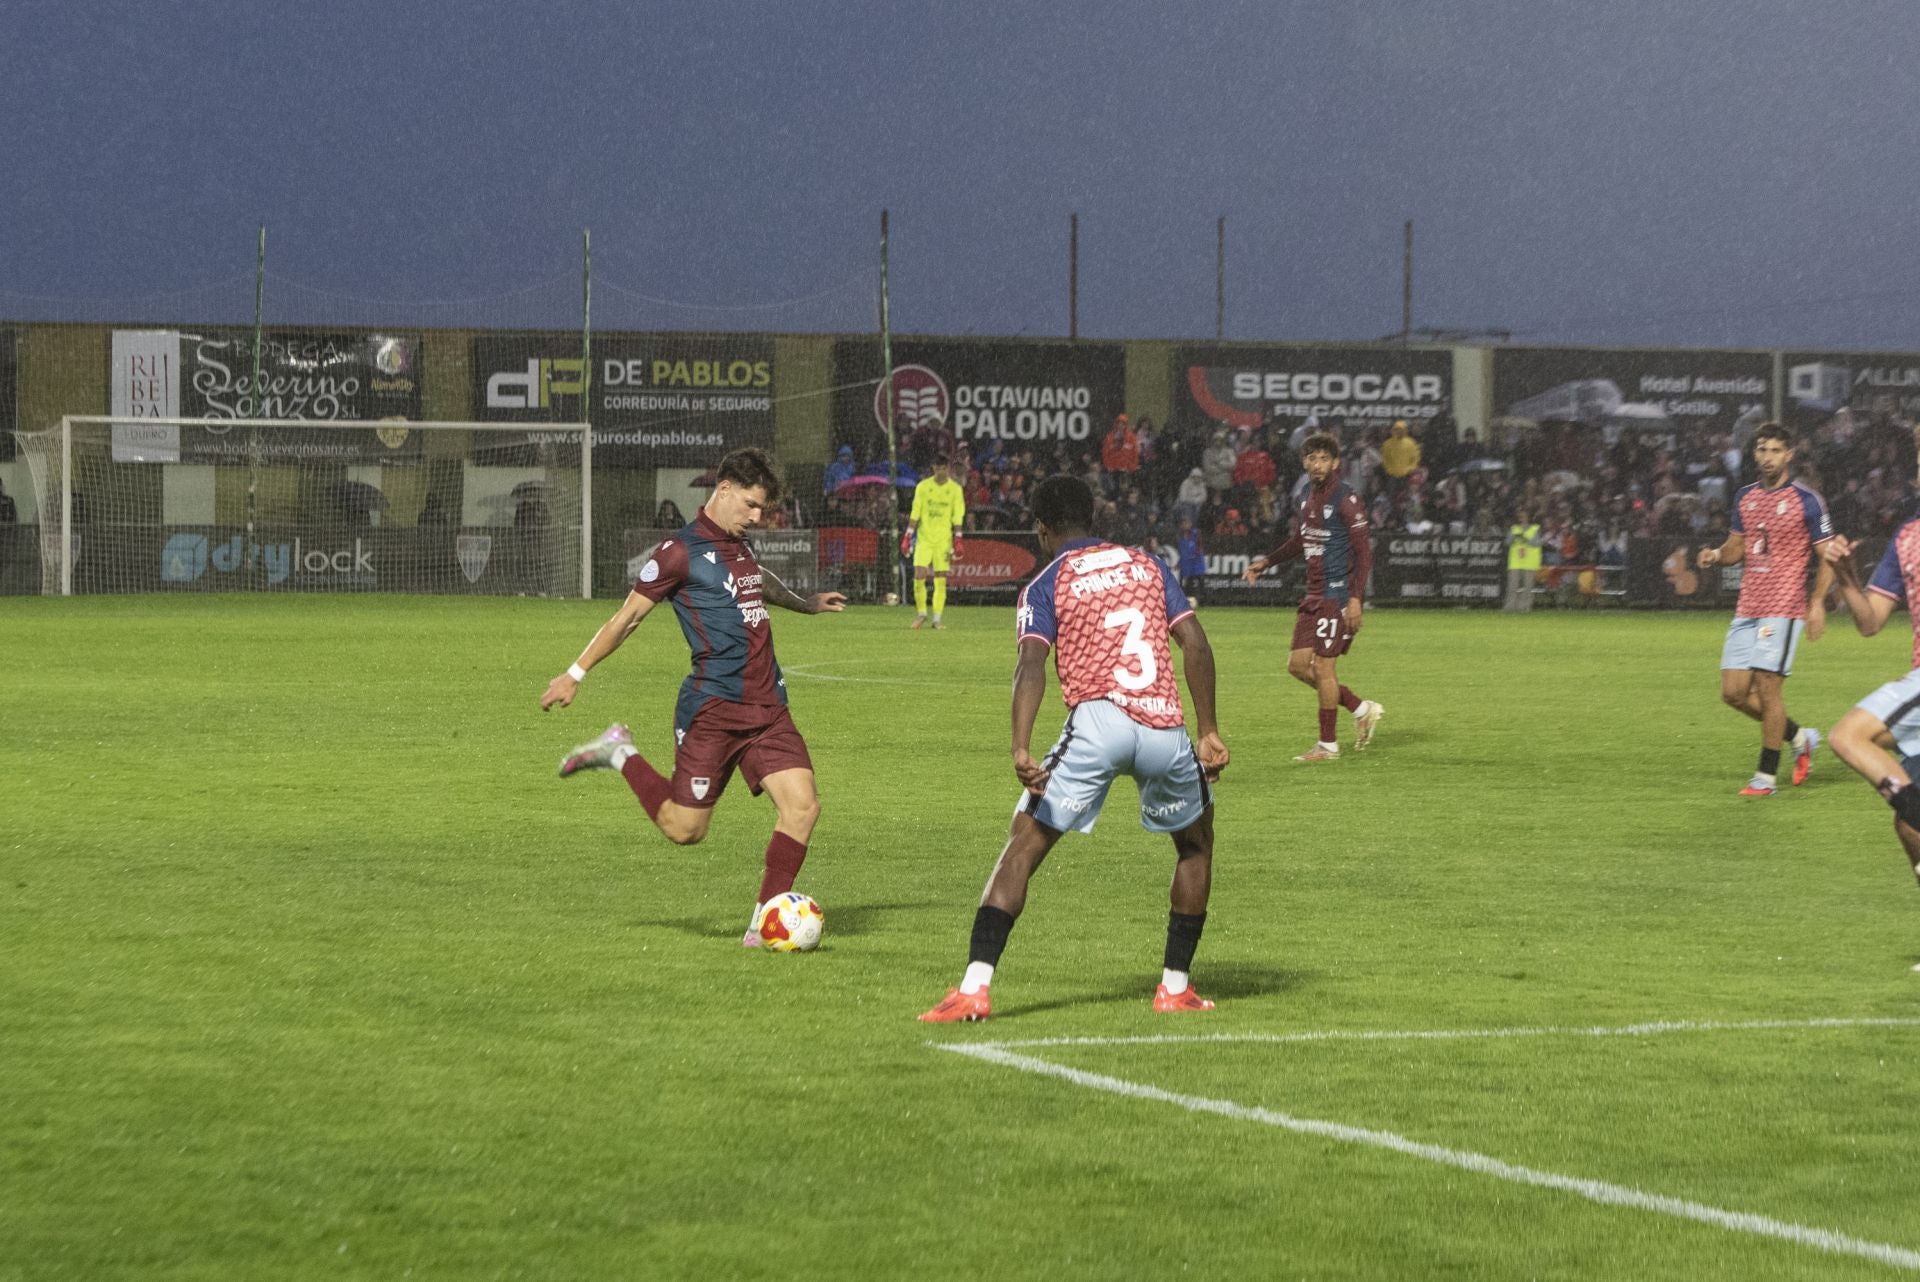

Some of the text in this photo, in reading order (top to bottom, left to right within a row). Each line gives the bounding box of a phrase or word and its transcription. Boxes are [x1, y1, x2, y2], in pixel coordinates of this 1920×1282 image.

[192, 340, 360, 395] Severino
[603, 359, 772, 388] DE PABLOS
[955, 385, 1091, 409] OCTAVIANO
[1232, 372, 1442, 401] SEGOCAR
[1639, 375, 1767, 394] Hotel Avenida
[201, 388, 340, 434] Sanz
[603, 393, 771, 412] CORREDURÍA DE SEGUROS
[1273, 403, 1440, 418] RECAMBIOS
[955, 409, 1091, 441] PALOMO
[754, 539, 812, 553] Avenida
[947, 563, 1013, 577] STOLAYA
[1070, 564, 1152, 598] PRINCE M.
[1315, 617, 1339, 638] 21
[1104, 607, 1158, 691] 3
